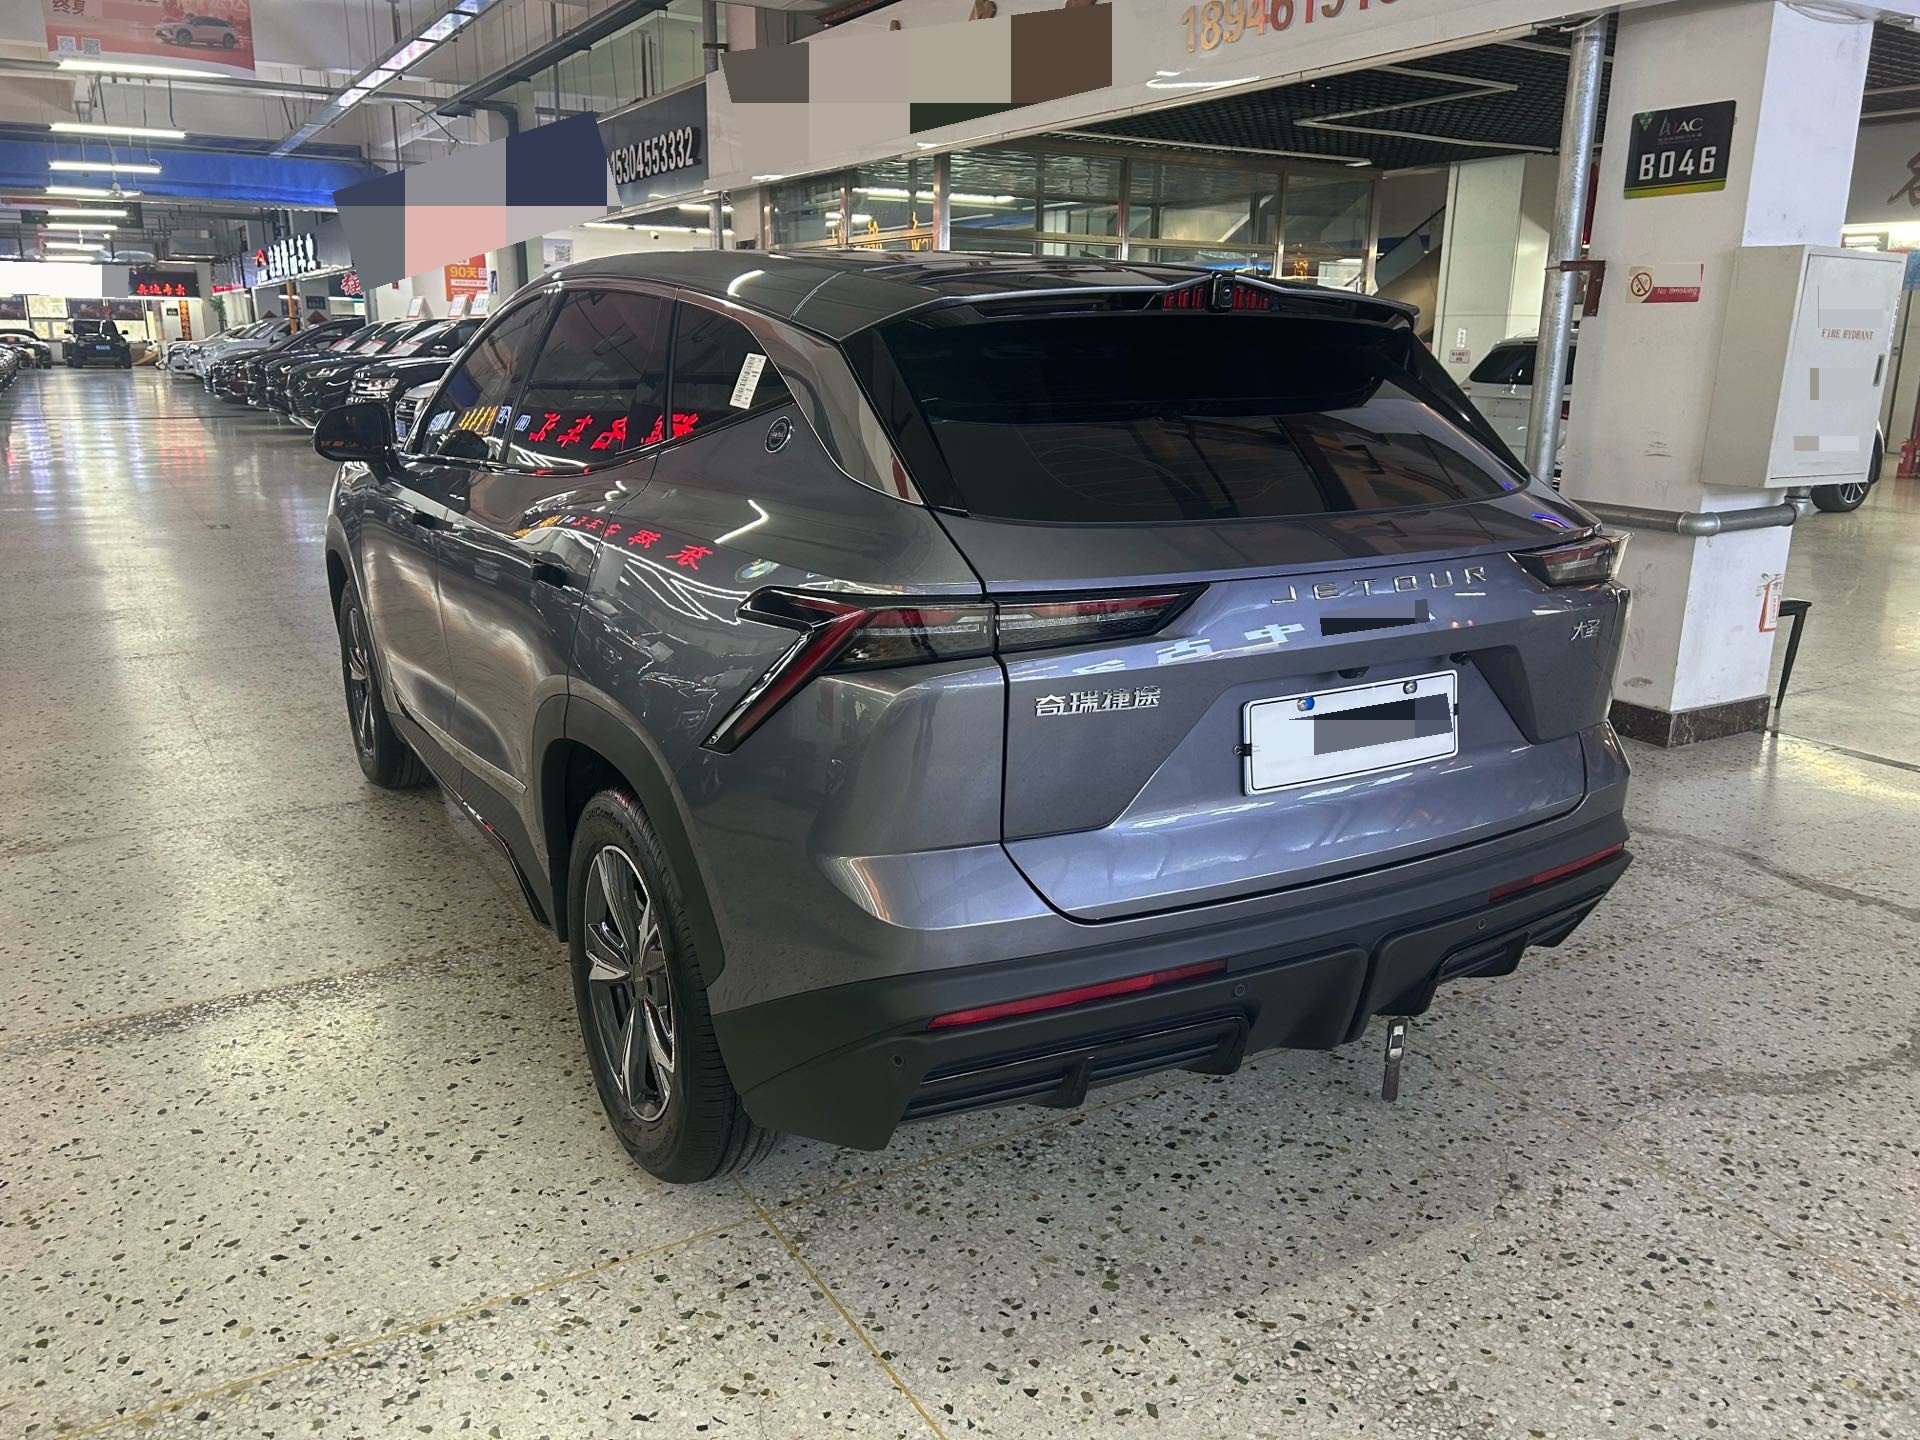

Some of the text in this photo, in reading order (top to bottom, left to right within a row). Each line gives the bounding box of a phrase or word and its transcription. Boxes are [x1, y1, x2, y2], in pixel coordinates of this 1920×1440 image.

[610, 126, 694, 185] 15304553332
[1638, 146, 1717, 181] B046
[1821, 328, 1875, 342] FIRE HYDRANT
[1271, 566, 1487, 604] JETOUR
[1034, 685, 1161, 717] 奇瑞捷途
